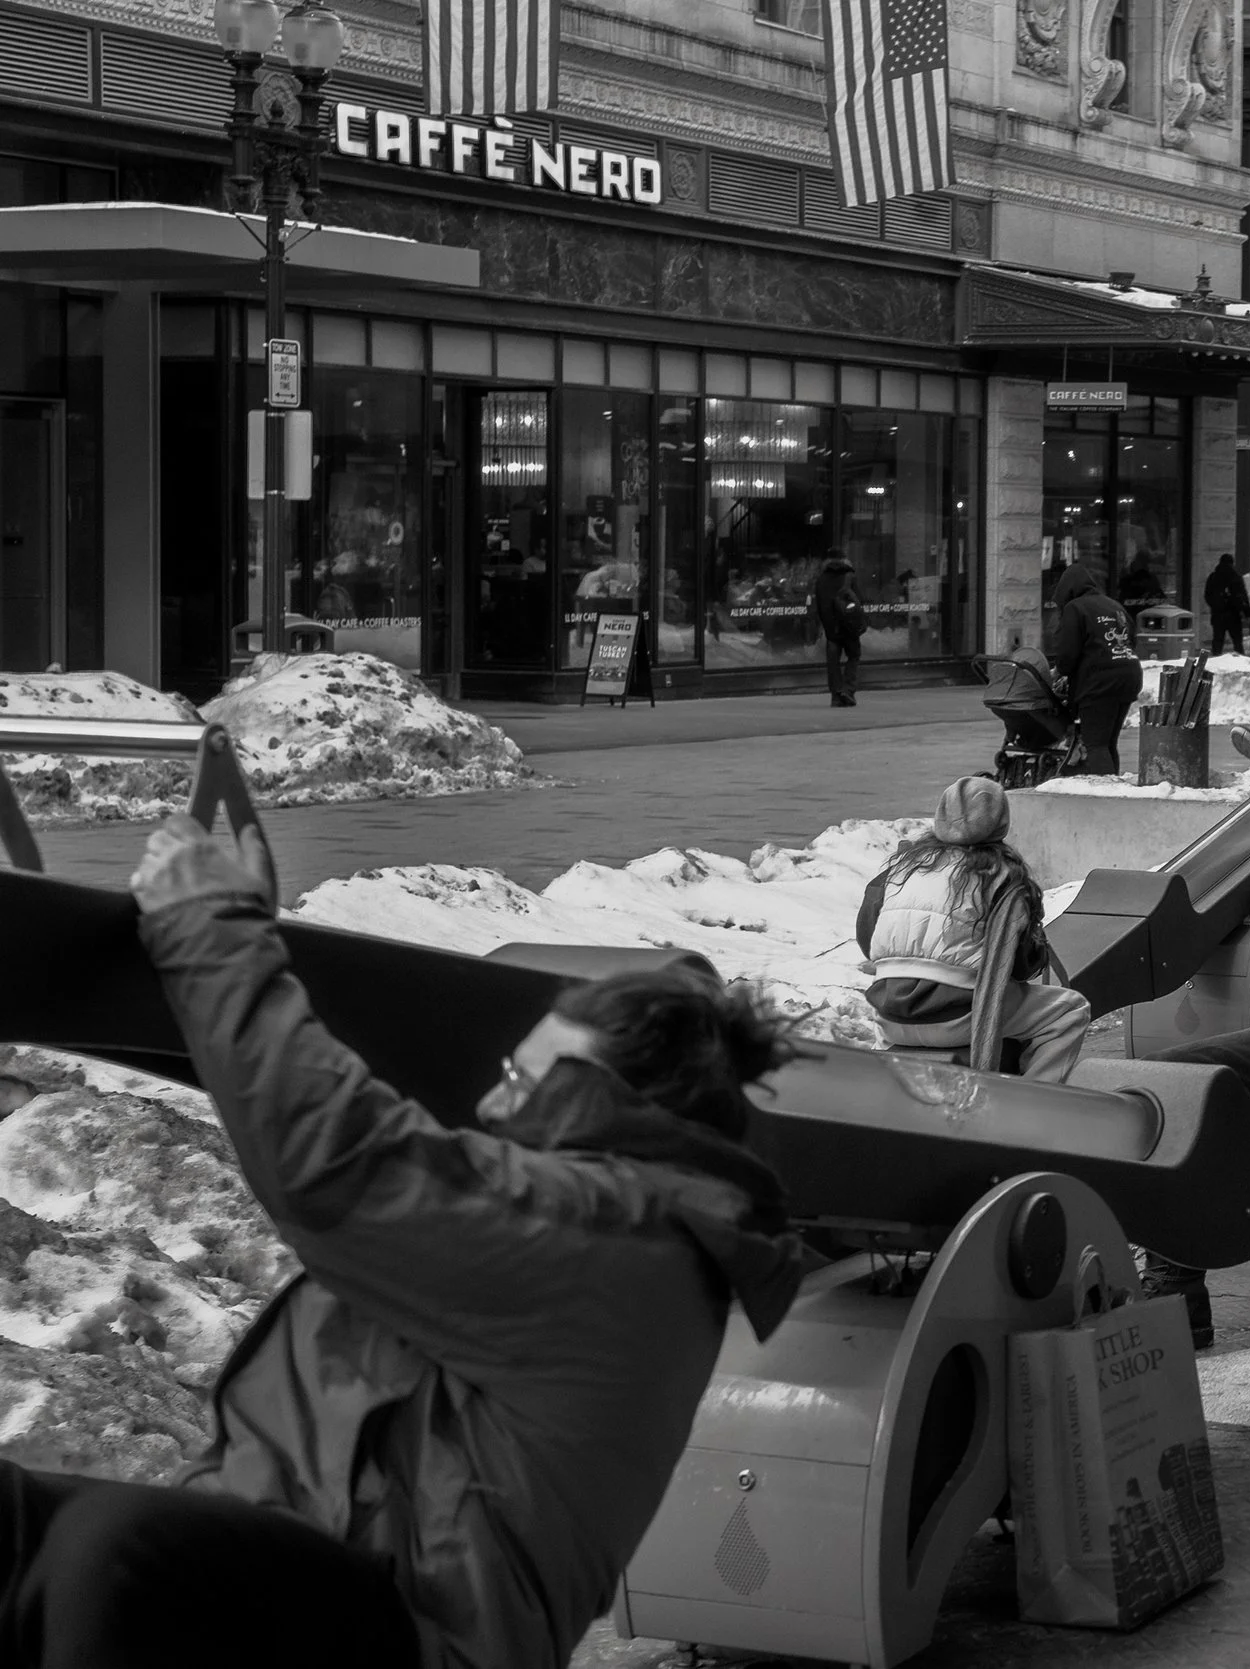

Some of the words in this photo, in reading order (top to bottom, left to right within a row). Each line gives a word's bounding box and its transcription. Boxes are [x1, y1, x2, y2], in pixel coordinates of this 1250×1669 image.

[336, 102, 515, 182] CAFFÈ
[531, 137, 662, 204] NERO
[280, 355, 289, 364] NO
[274, 363, 296, 373] STOPPING
[1089, 391, 1123, 400] NERO
[604, 623, 632, 631] NERO
[600, 644, 628, 652] TUSCAN
[1109, 1348, 1164, 1385] SHOP
[1066, 1373, 1081, 1435] AMERICA
[1072, 1442, 1083, 1459] IN
